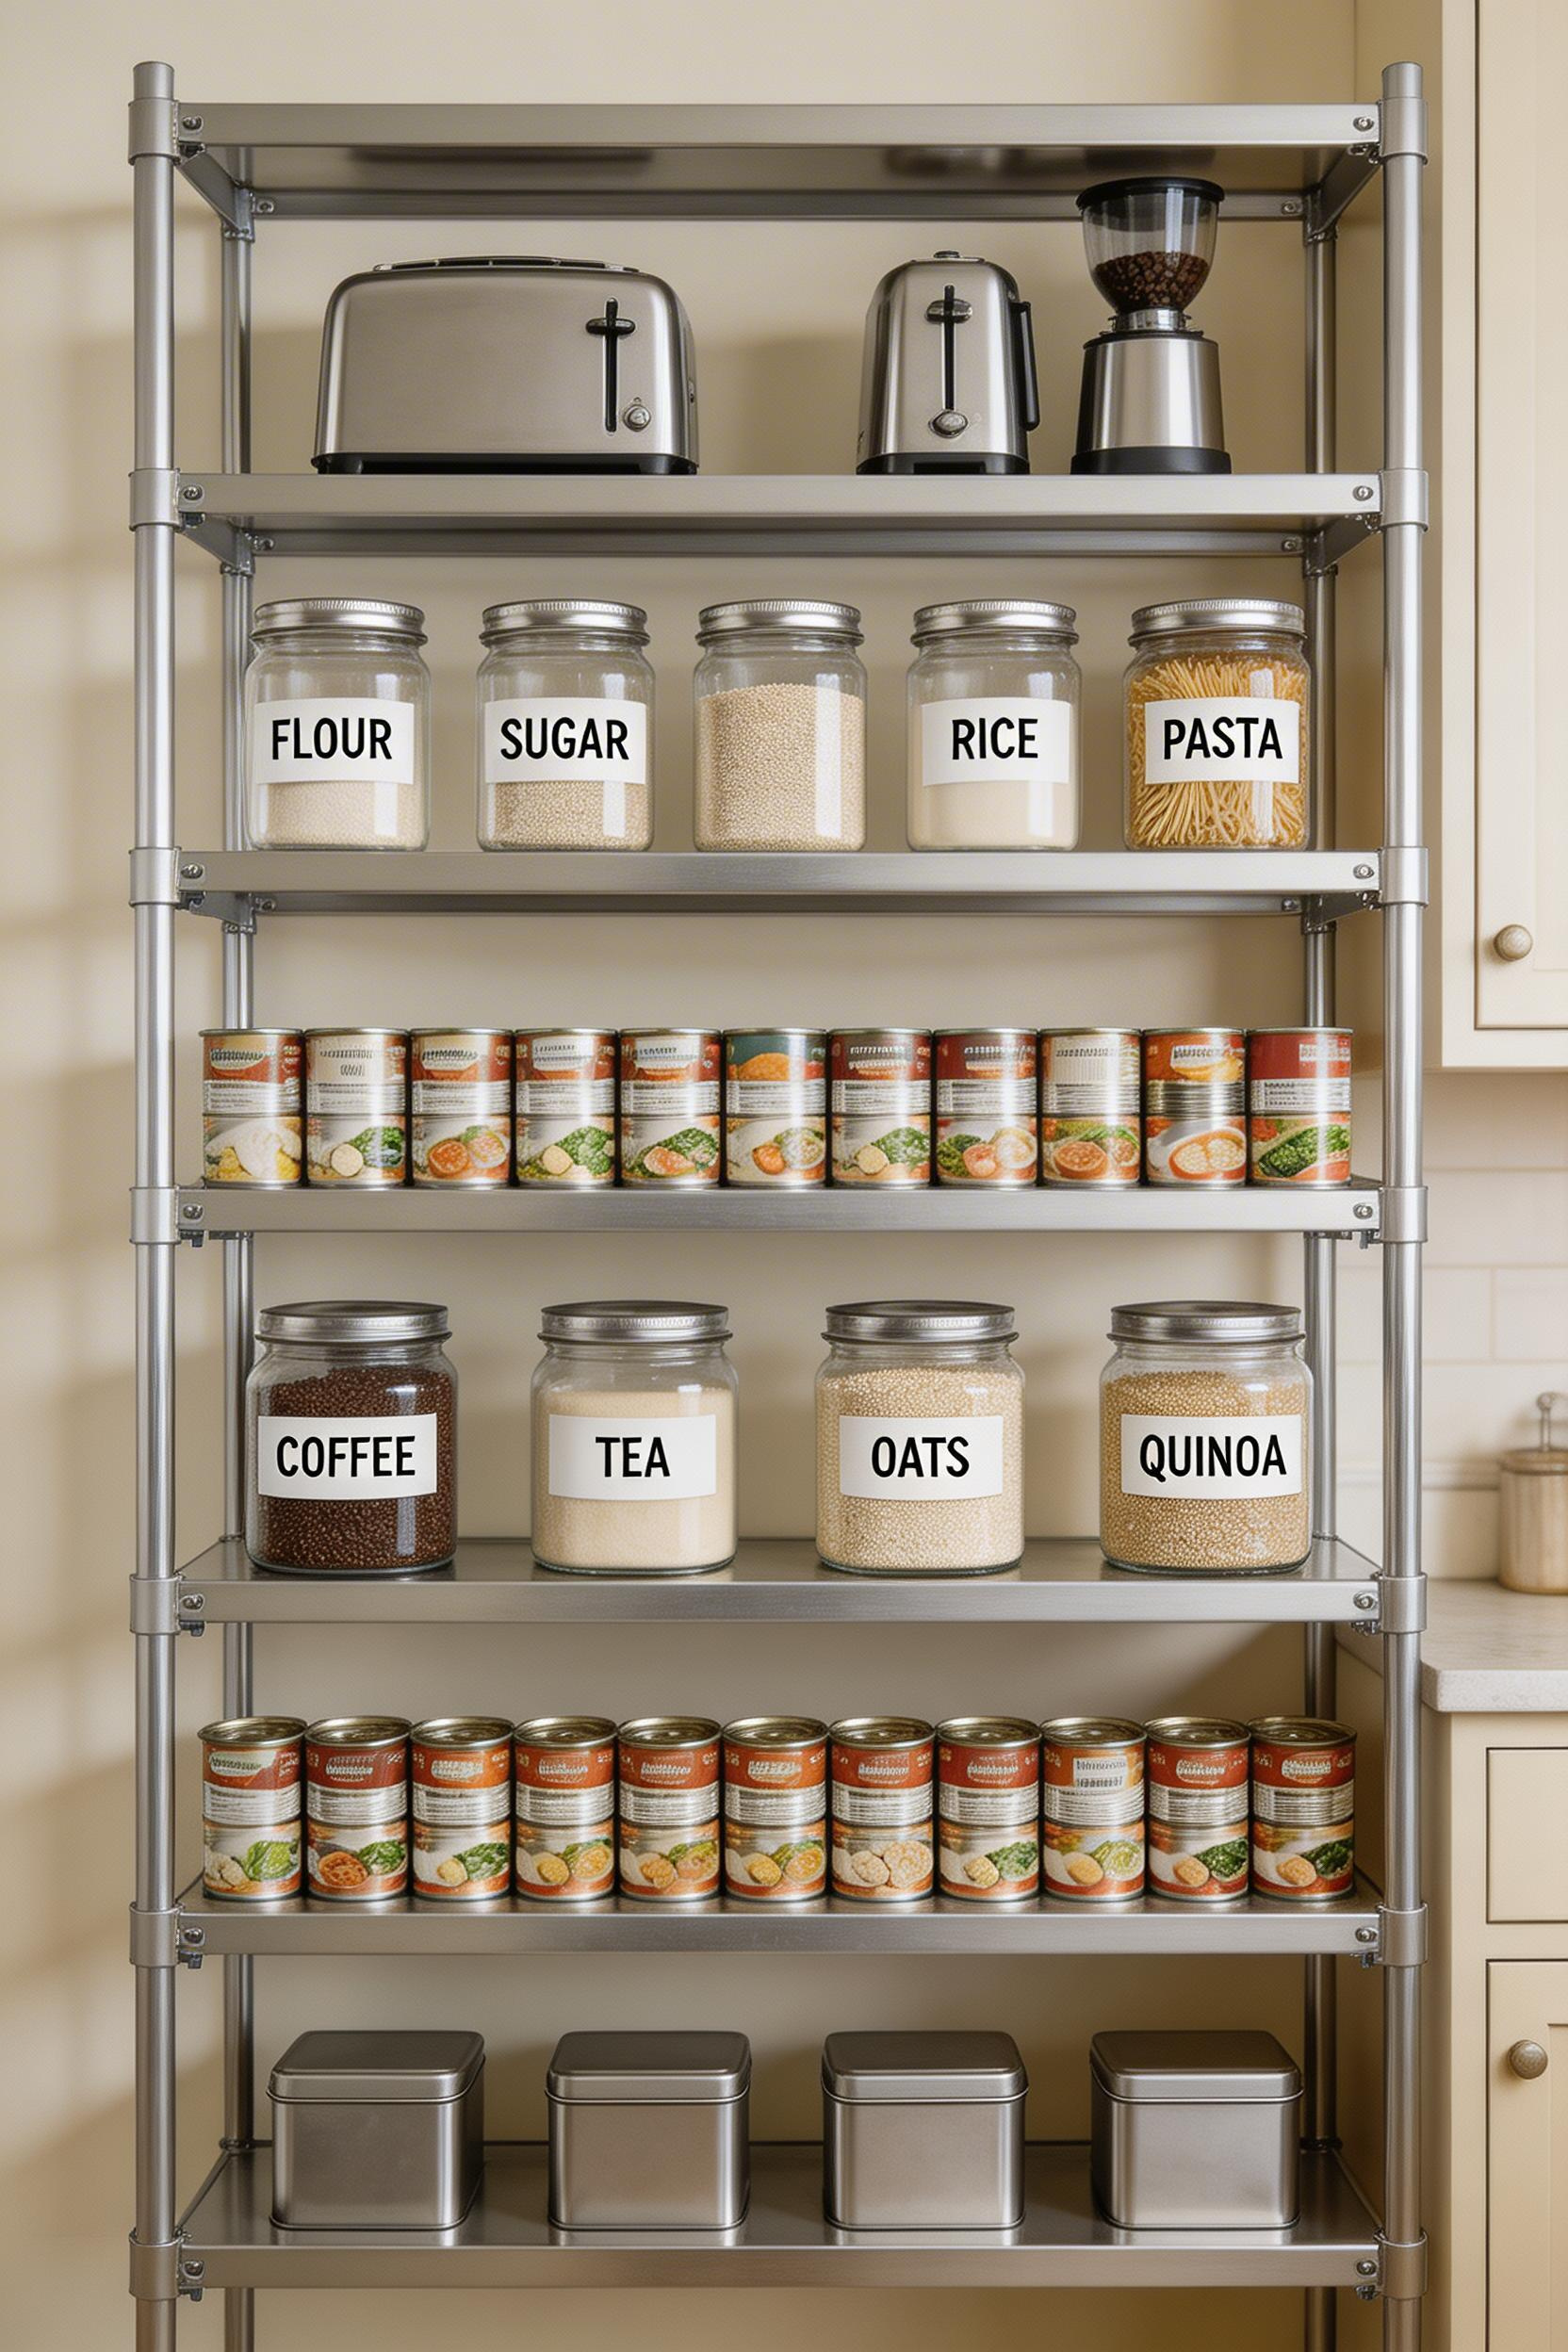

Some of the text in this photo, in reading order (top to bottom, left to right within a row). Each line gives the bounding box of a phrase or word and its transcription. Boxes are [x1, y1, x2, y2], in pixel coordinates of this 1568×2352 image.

[271, 717, 392, 760] FLOUR
[500, 716, 629, 760] SUGAR
[952, 716, 1038, 760] RICE
[1164, 716, 1283, 760] PASTA
[276, 1435, 416, 1478] COFFEE
[595, 1436, 671, 1478] TEA
[871, 1436, 970, 1478] OATS
[1139, 1433, 1287, 1483] QUINOA
